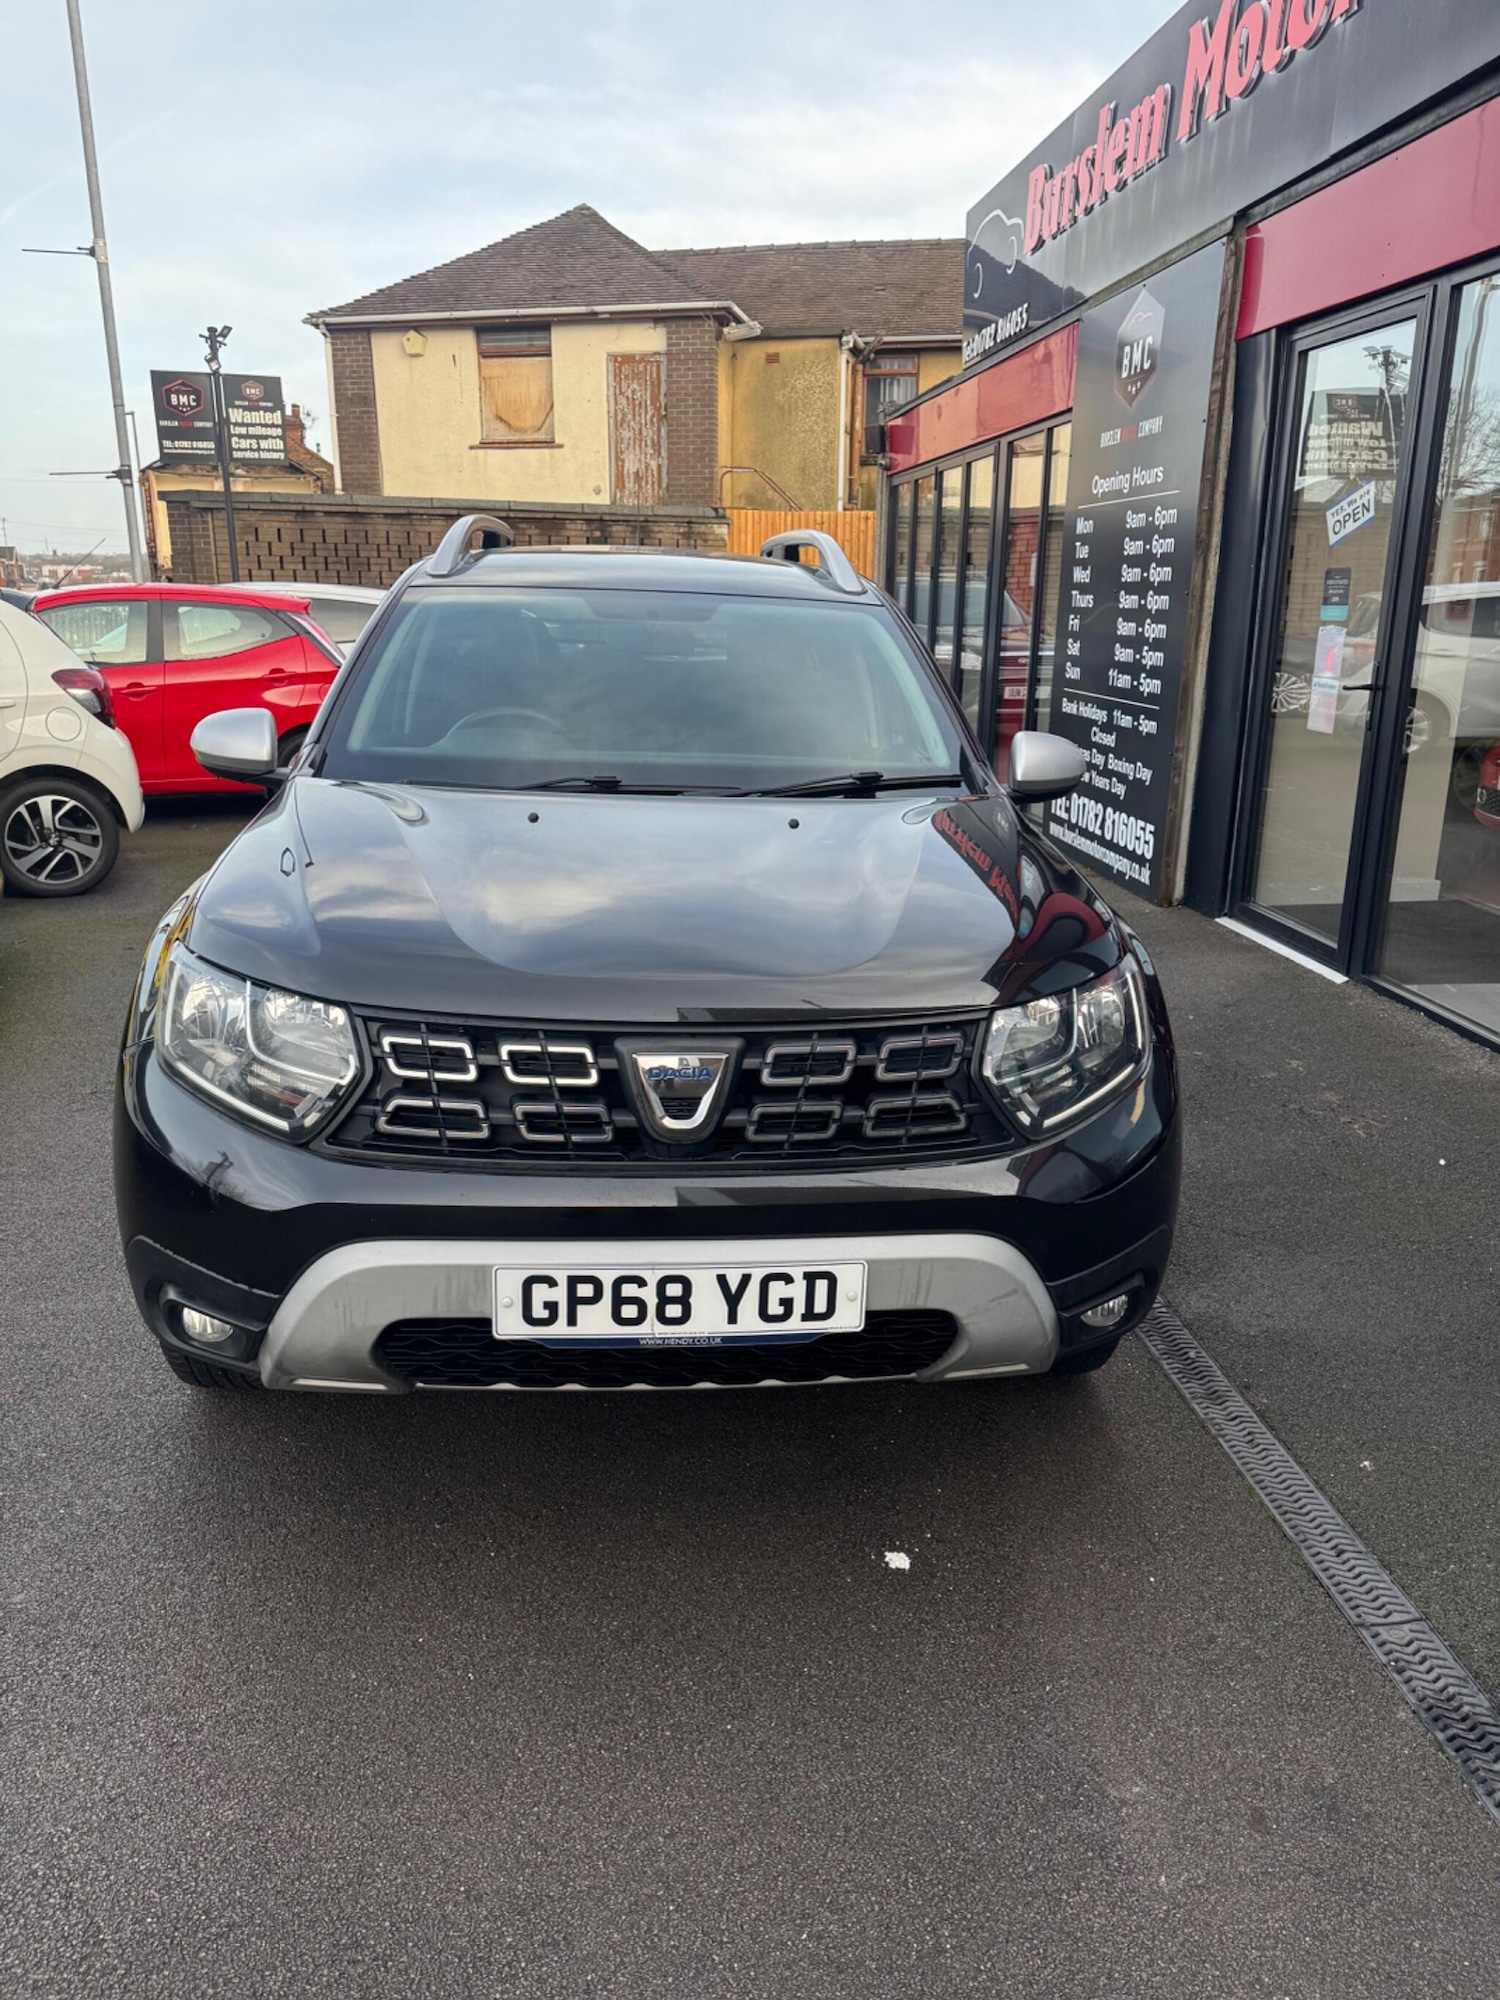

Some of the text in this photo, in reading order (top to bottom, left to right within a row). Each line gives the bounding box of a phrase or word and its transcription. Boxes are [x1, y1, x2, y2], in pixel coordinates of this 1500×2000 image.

[1023, 0, 1362, 256] Burslem Moto
[1121, 336, 1153, 379] BMC
[170, 394, 197, 406] BMC
[228, 408, 282, 425] Wanted
[230, 425, 282, 437] Low mileage
[231, 436, 284, 450] Cars with
[232, 451, 285, 461] service history
[1092, 466, 1164, 498] Opening Hours
[1076, 517, 1094, 534] Mon
[1125, 510, 1146, 529] 9am
[1154, 506, 1178, 529] 6pm
[1332, 497, 1371, 535] OPEN
[1075, 542, 1089, 559] Tue
[1123, 537, 1144, 556] 9am
[1151, 534, 1175, 558] 6pm
[1073, 566, 1092, 583] Wed
[1121, 564, 1141, 582] 9am
[1149, 562, 1172, 586] 6pm
[1071, 590, 1094, 608] Thurs
[1118, 590, 1139, 609] 9am
[1146, 590, 1170, 614] 6pm
[1068, 614, 1080, 632] Fri
[1116, 617, 1137, 636] 9am
[1144, 618, 1167, 642] 6pm
[1066, 638, 1080, 656] Sat
[1114, 643, 1134, 662] 9am
[1141, 646, 1164, 670] 5pm
[1065, 661, 1080, 680] Sun
[1108, 668, 1132, 689] 11am
[1139, 673, 1161, 697] 5pm
[1062, 697, 1079, 716] Bank
[1079, 701, 1108, 725] Holidays
[1113, 708, 1133, 729] 11am
[1138, 714, 1158, 736] 5pm
[1091, 726, 1117, 748] Closed
[1091, 748, 1106, 770] Day
[1107, 753, 1135, 780] Boxing
[1135, 761, 1153, 786] Day
[1091, 769, 1110, 791] Years
[1111, 777, 1127, 800] Day
[1051, 793, 1155, 860] TEL: 01782 816055
[648, 1067, 713, 1080] DACIA
[521, 1270, 838, 1327] GP68 YGD
[639, 1336, 722, 1346] WWW.HENDY.CO.UK
